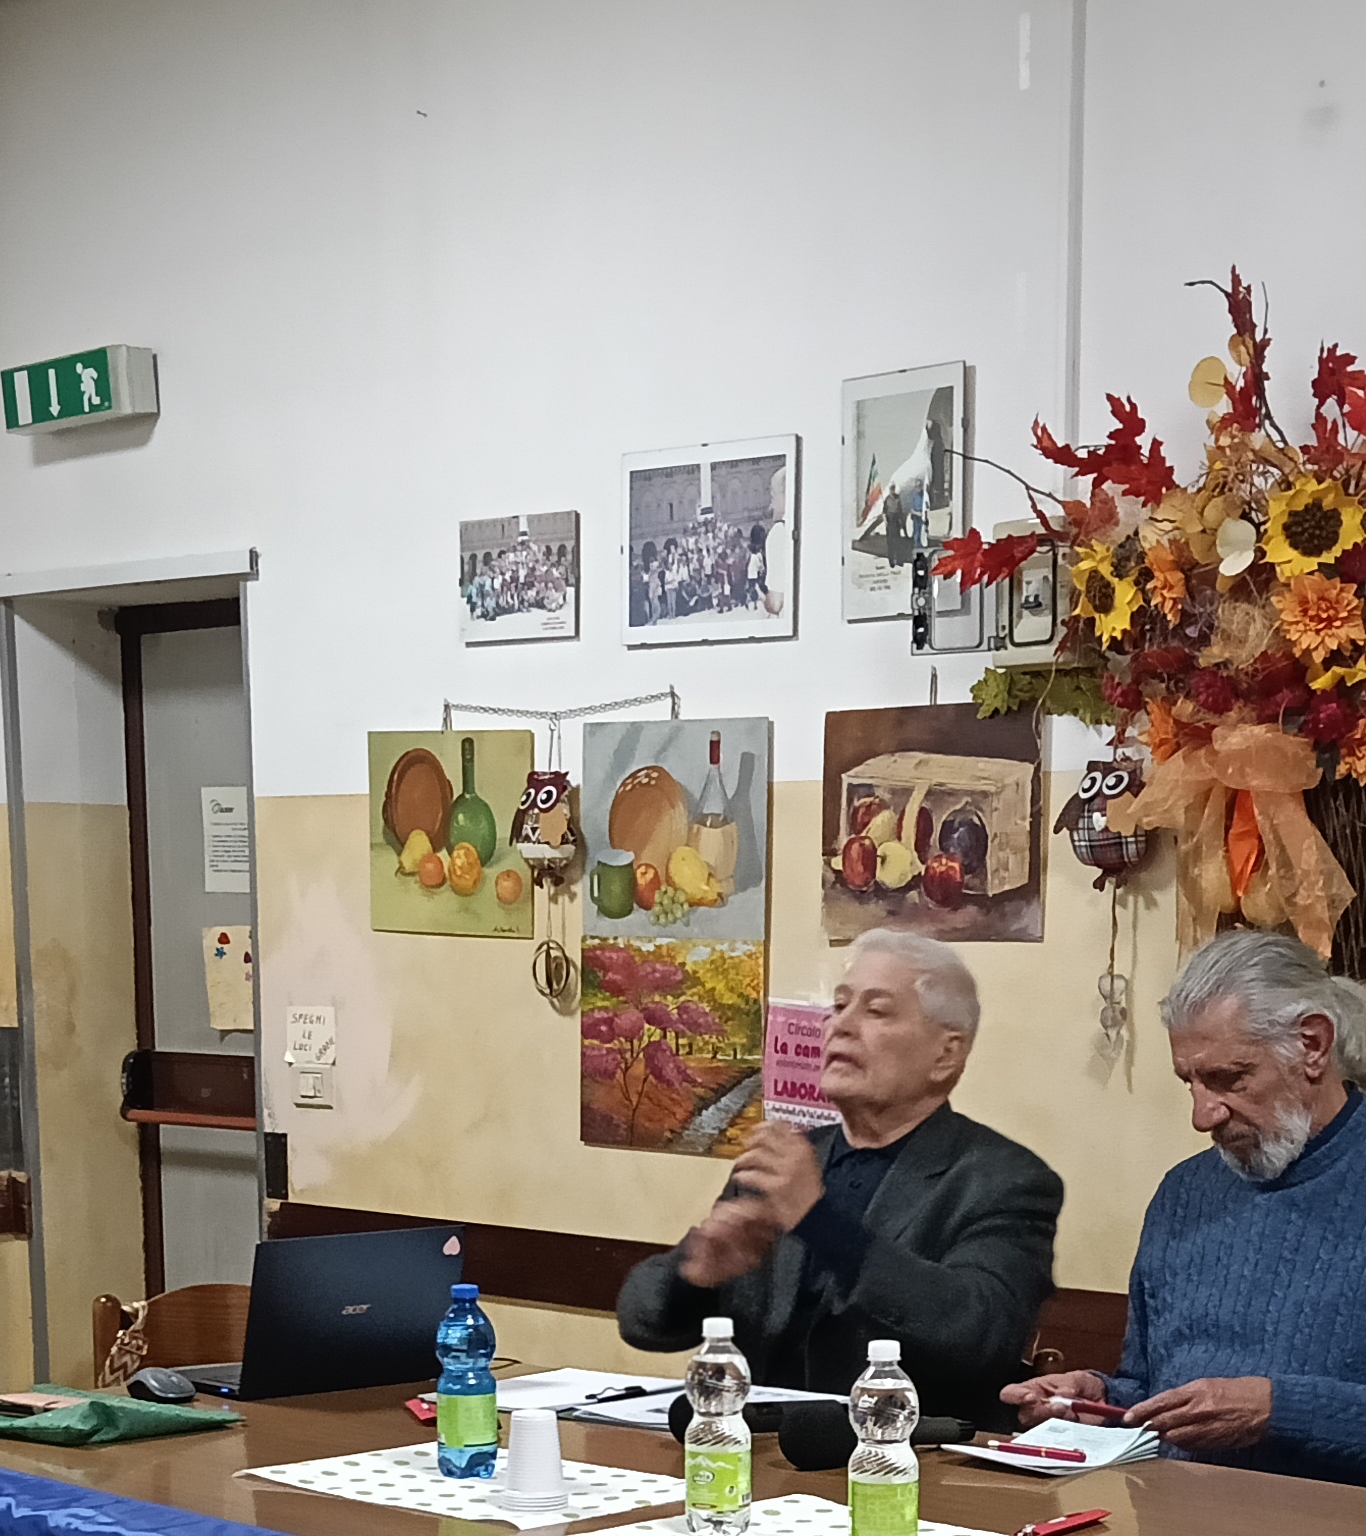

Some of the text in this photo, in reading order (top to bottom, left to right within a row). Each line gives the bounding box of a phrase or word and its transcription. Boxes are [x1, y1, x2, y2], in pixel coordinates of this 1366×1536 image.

[302, 1029, 313, 1040] LE
[773, 1078, 833, 1104] LABORA
[341, 1303, 371, 1315] acer
